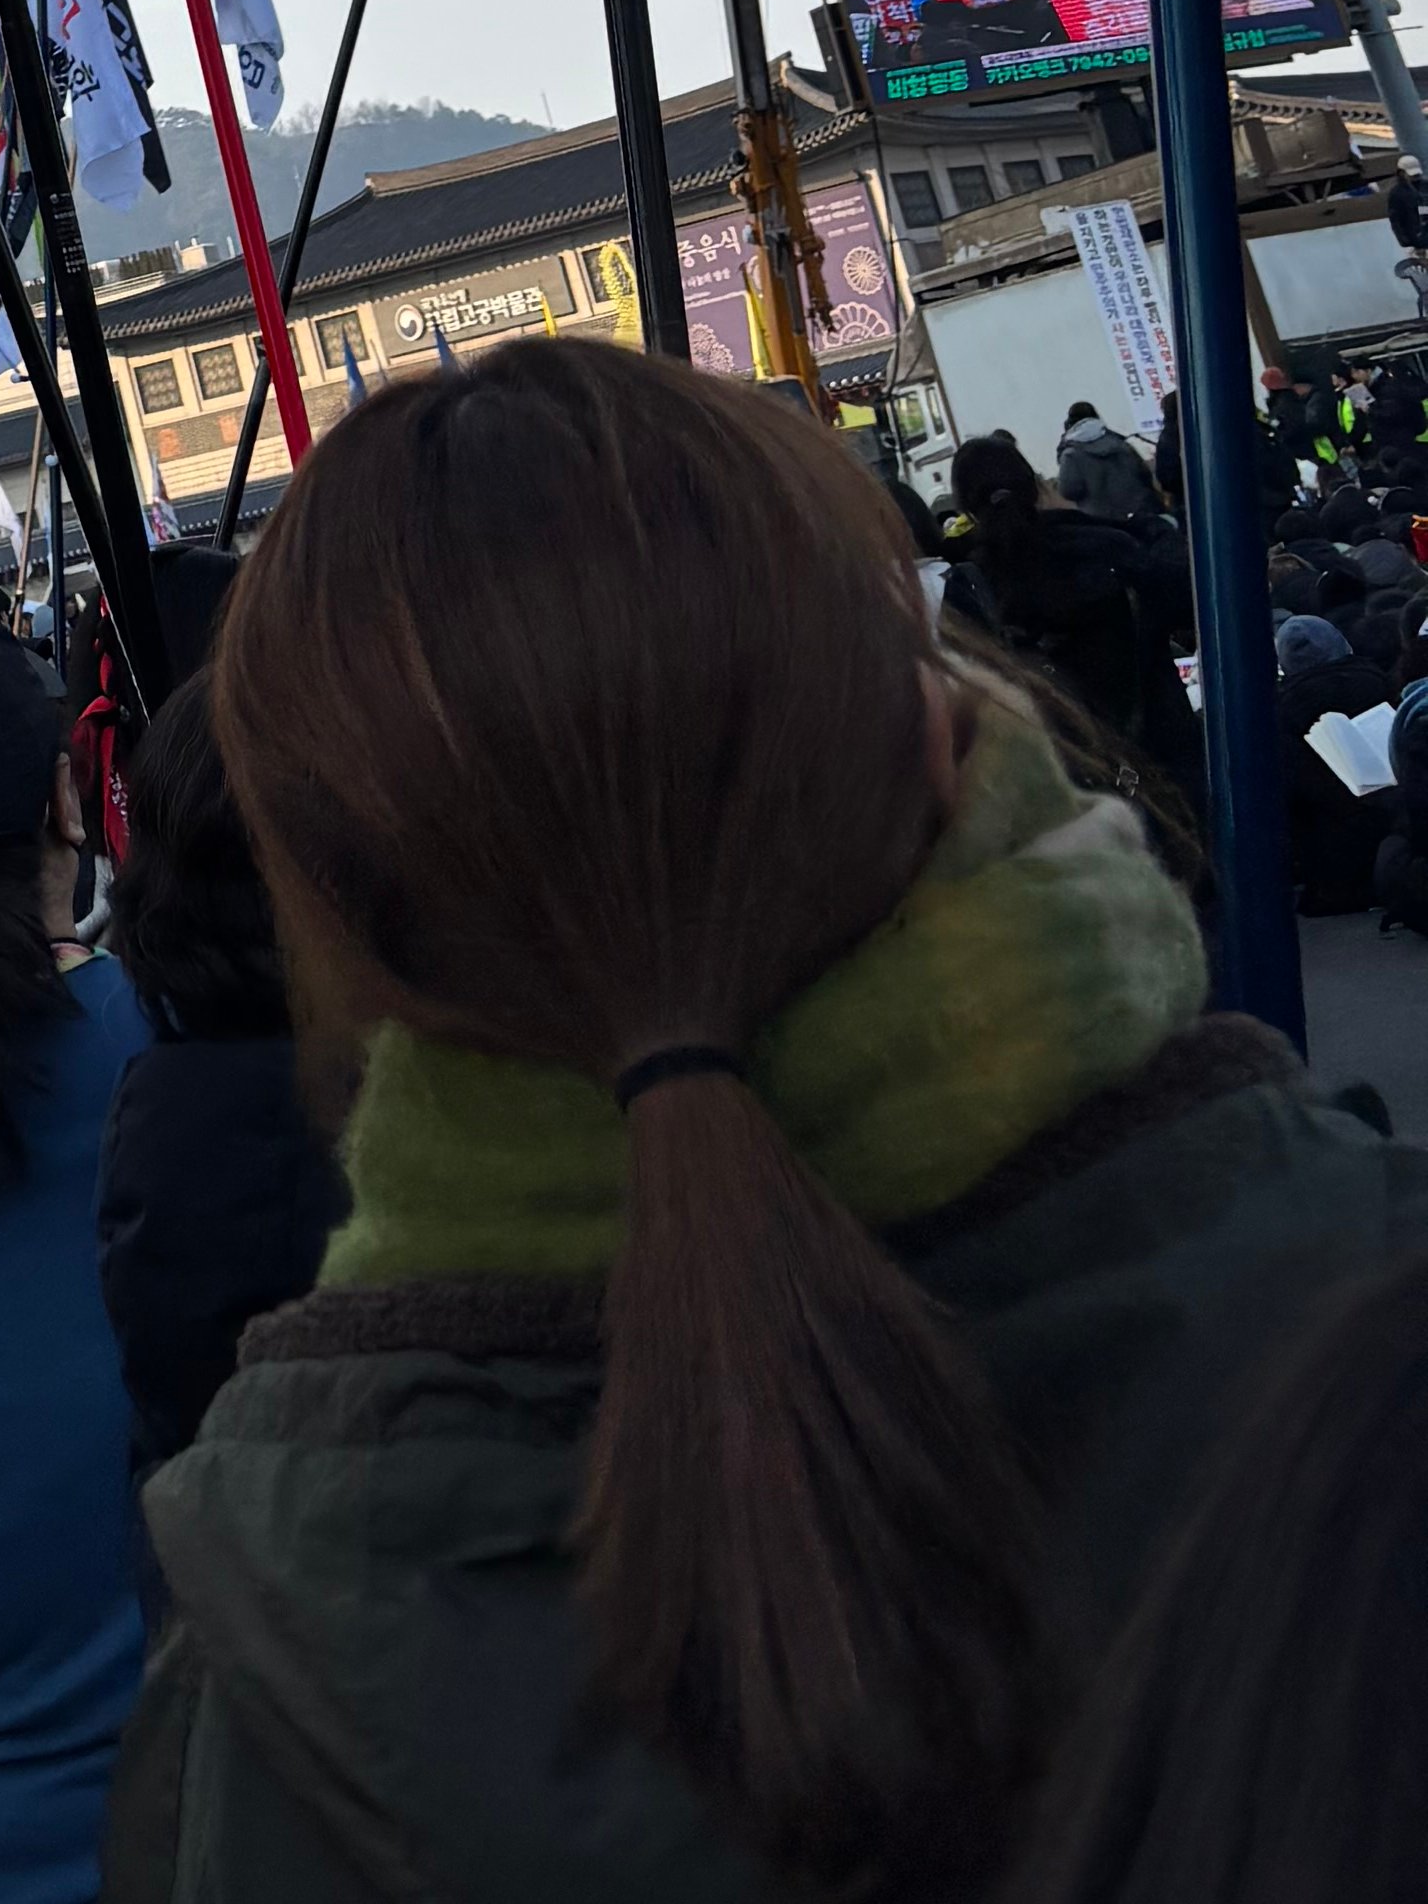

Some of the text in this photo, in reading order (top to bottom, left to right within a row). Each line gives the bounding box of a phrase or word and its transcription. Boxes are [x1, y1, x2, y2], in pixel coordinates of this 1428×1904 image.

[886, 68, 969, 99] 비상행동
[985, 56, 1068, 84] 카카오뱅크
[677, 225, 742, 268] 중음식
[425, 285, 545, 334] 국립고궁박물관
